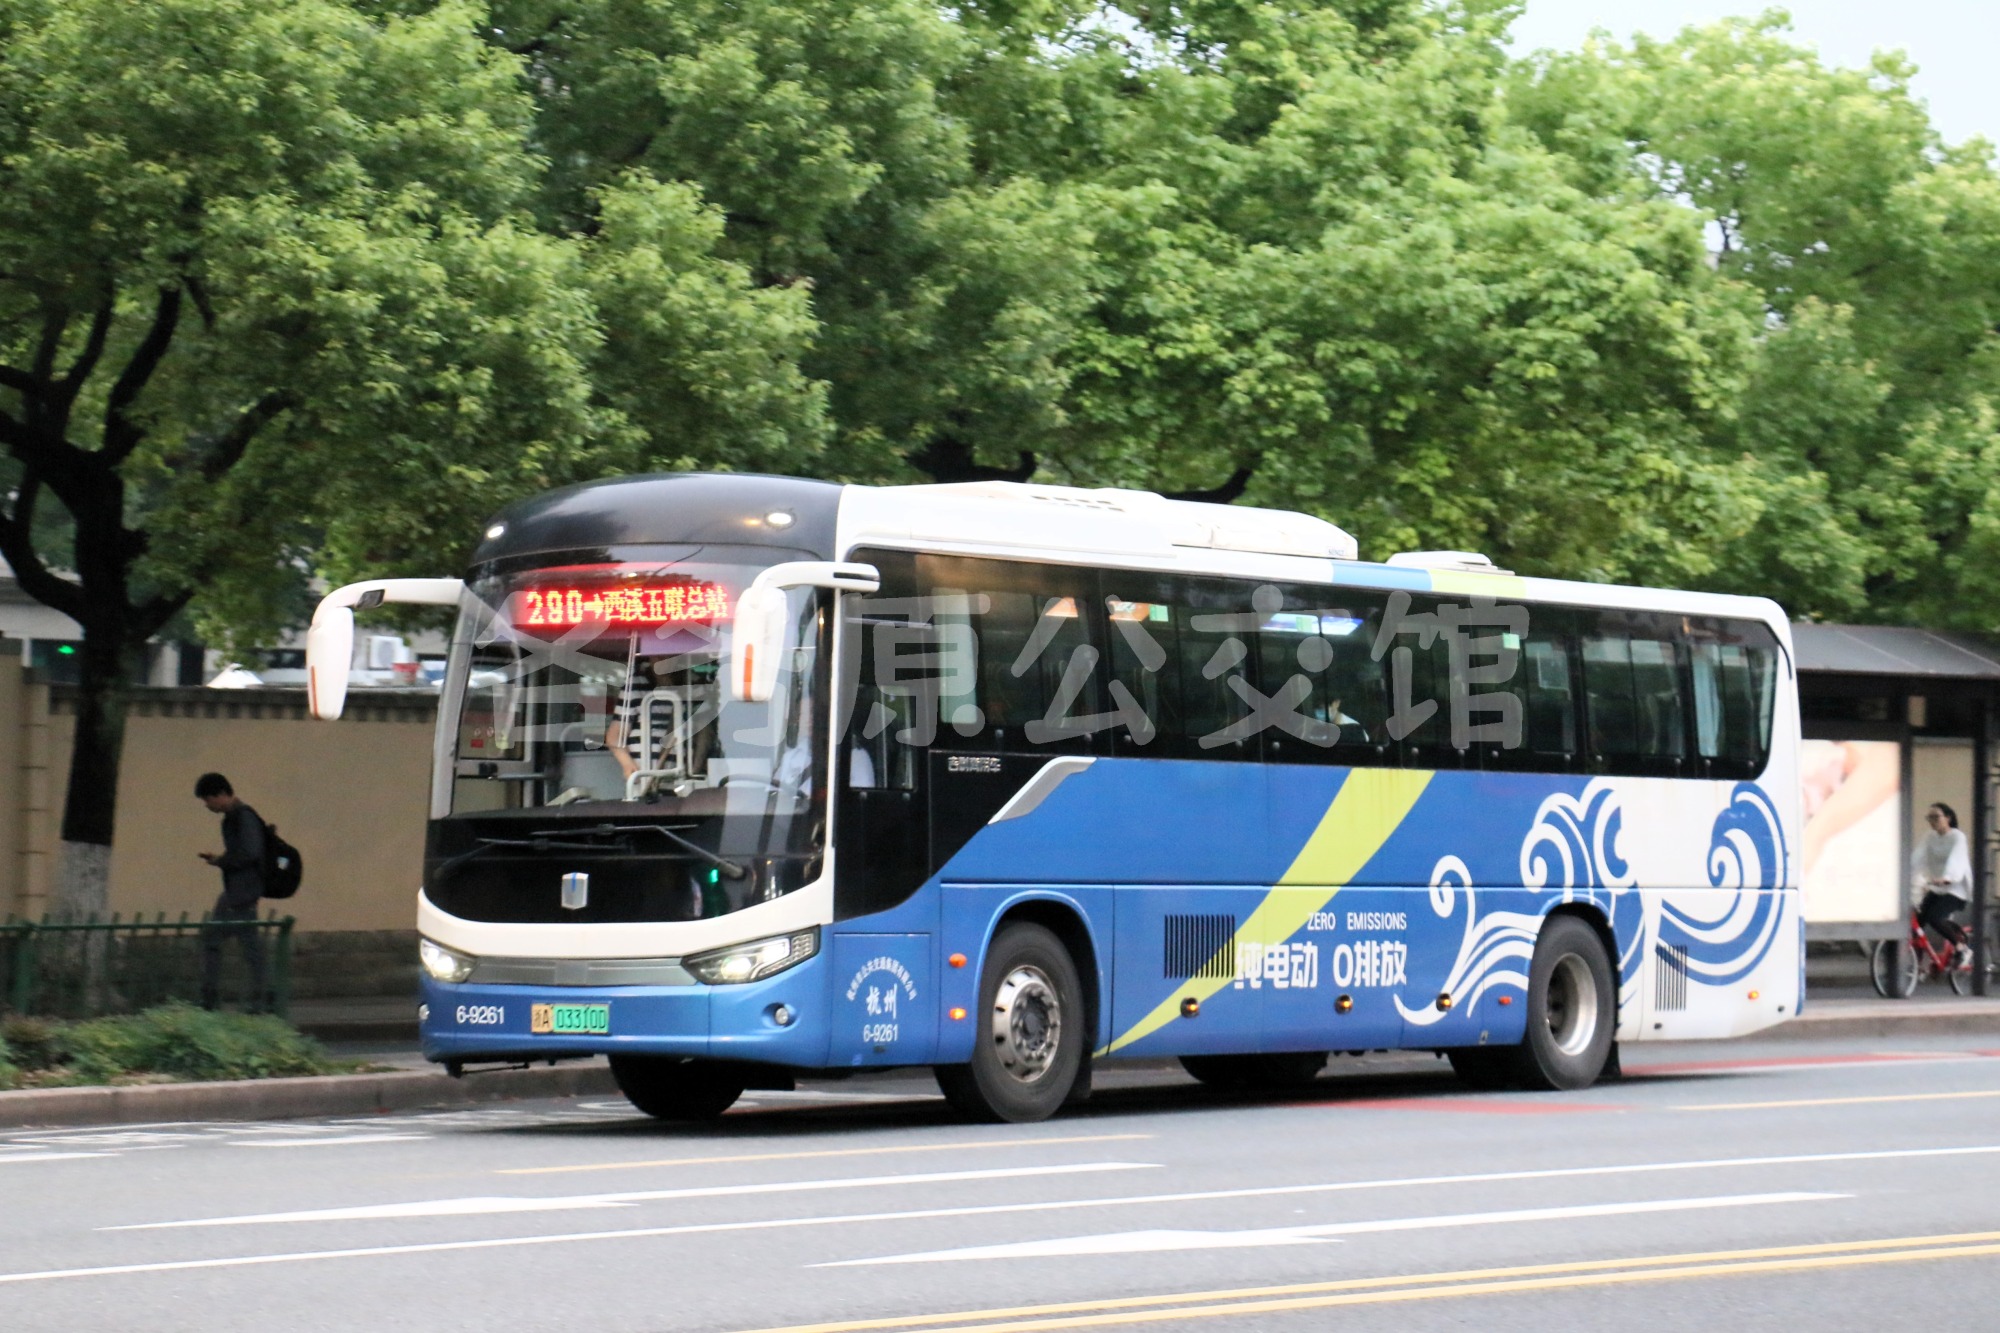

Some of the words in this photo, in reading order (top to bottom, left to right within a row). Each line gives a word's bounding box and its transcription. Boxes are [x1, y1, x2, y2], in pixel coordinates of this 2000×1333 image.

[526, 591, 584, 625] 280
[602, 586, 728, 621] 西溪五联总站
[1306, 911, 1336, 931] ZERO
[1347, 911, 1407, 931] EMISSIONS
[1234, 940, 1319, 990] 纯电动
[455, 1005, 505, 1025] 6-9261
[865, 983, 899, 1020] 杭州
[863, 1023, 899, 1043] 6-9261
